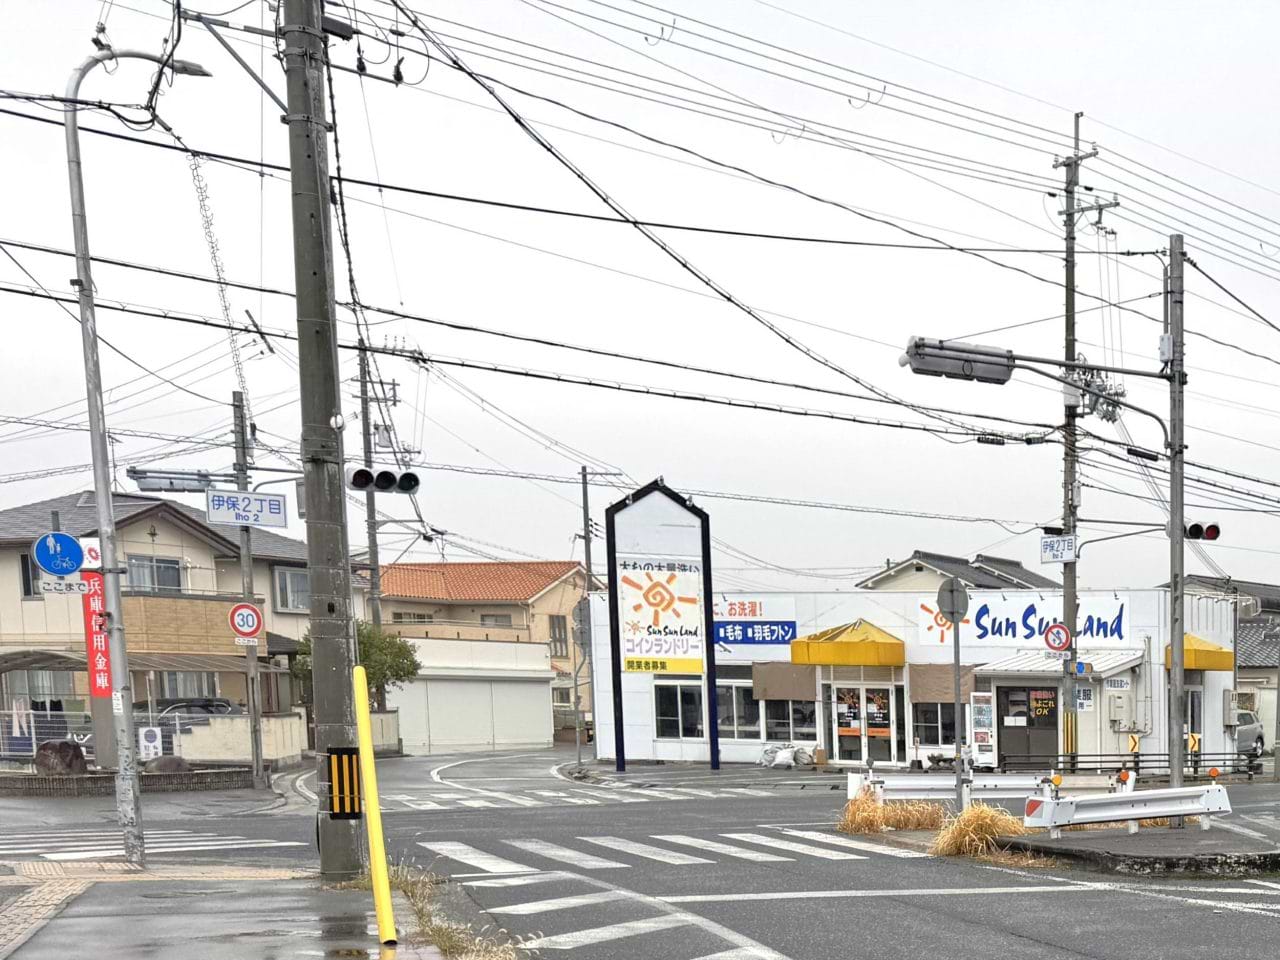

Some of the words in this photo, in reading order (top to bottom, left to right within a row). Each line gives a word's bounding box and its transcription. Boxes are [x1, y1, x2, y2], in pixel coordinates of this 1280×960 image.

[211, 494, 281, 515] 伊保2丁目
[253, 514, 260, 522] 2
[1043, 539, 1073, 553] 伊保2丁目
[42, 581, 87, 593] ここまで
[236, 612, 255, 628] 30
[975, 603, 1017, 640] Sun
[1022, 603, 1064, 640] Su
[646, 625, 662, 636] Sun
[663, 625, 678, 636] Sun
[679, 625, 698, 637] Land
[725, 624, 743, 641] 毛布
[753, 624, 793, 641] 羽毛フトン
[626, 637, 699, 655] コインランドリー
[1036, 708, 1049, 716] OK
